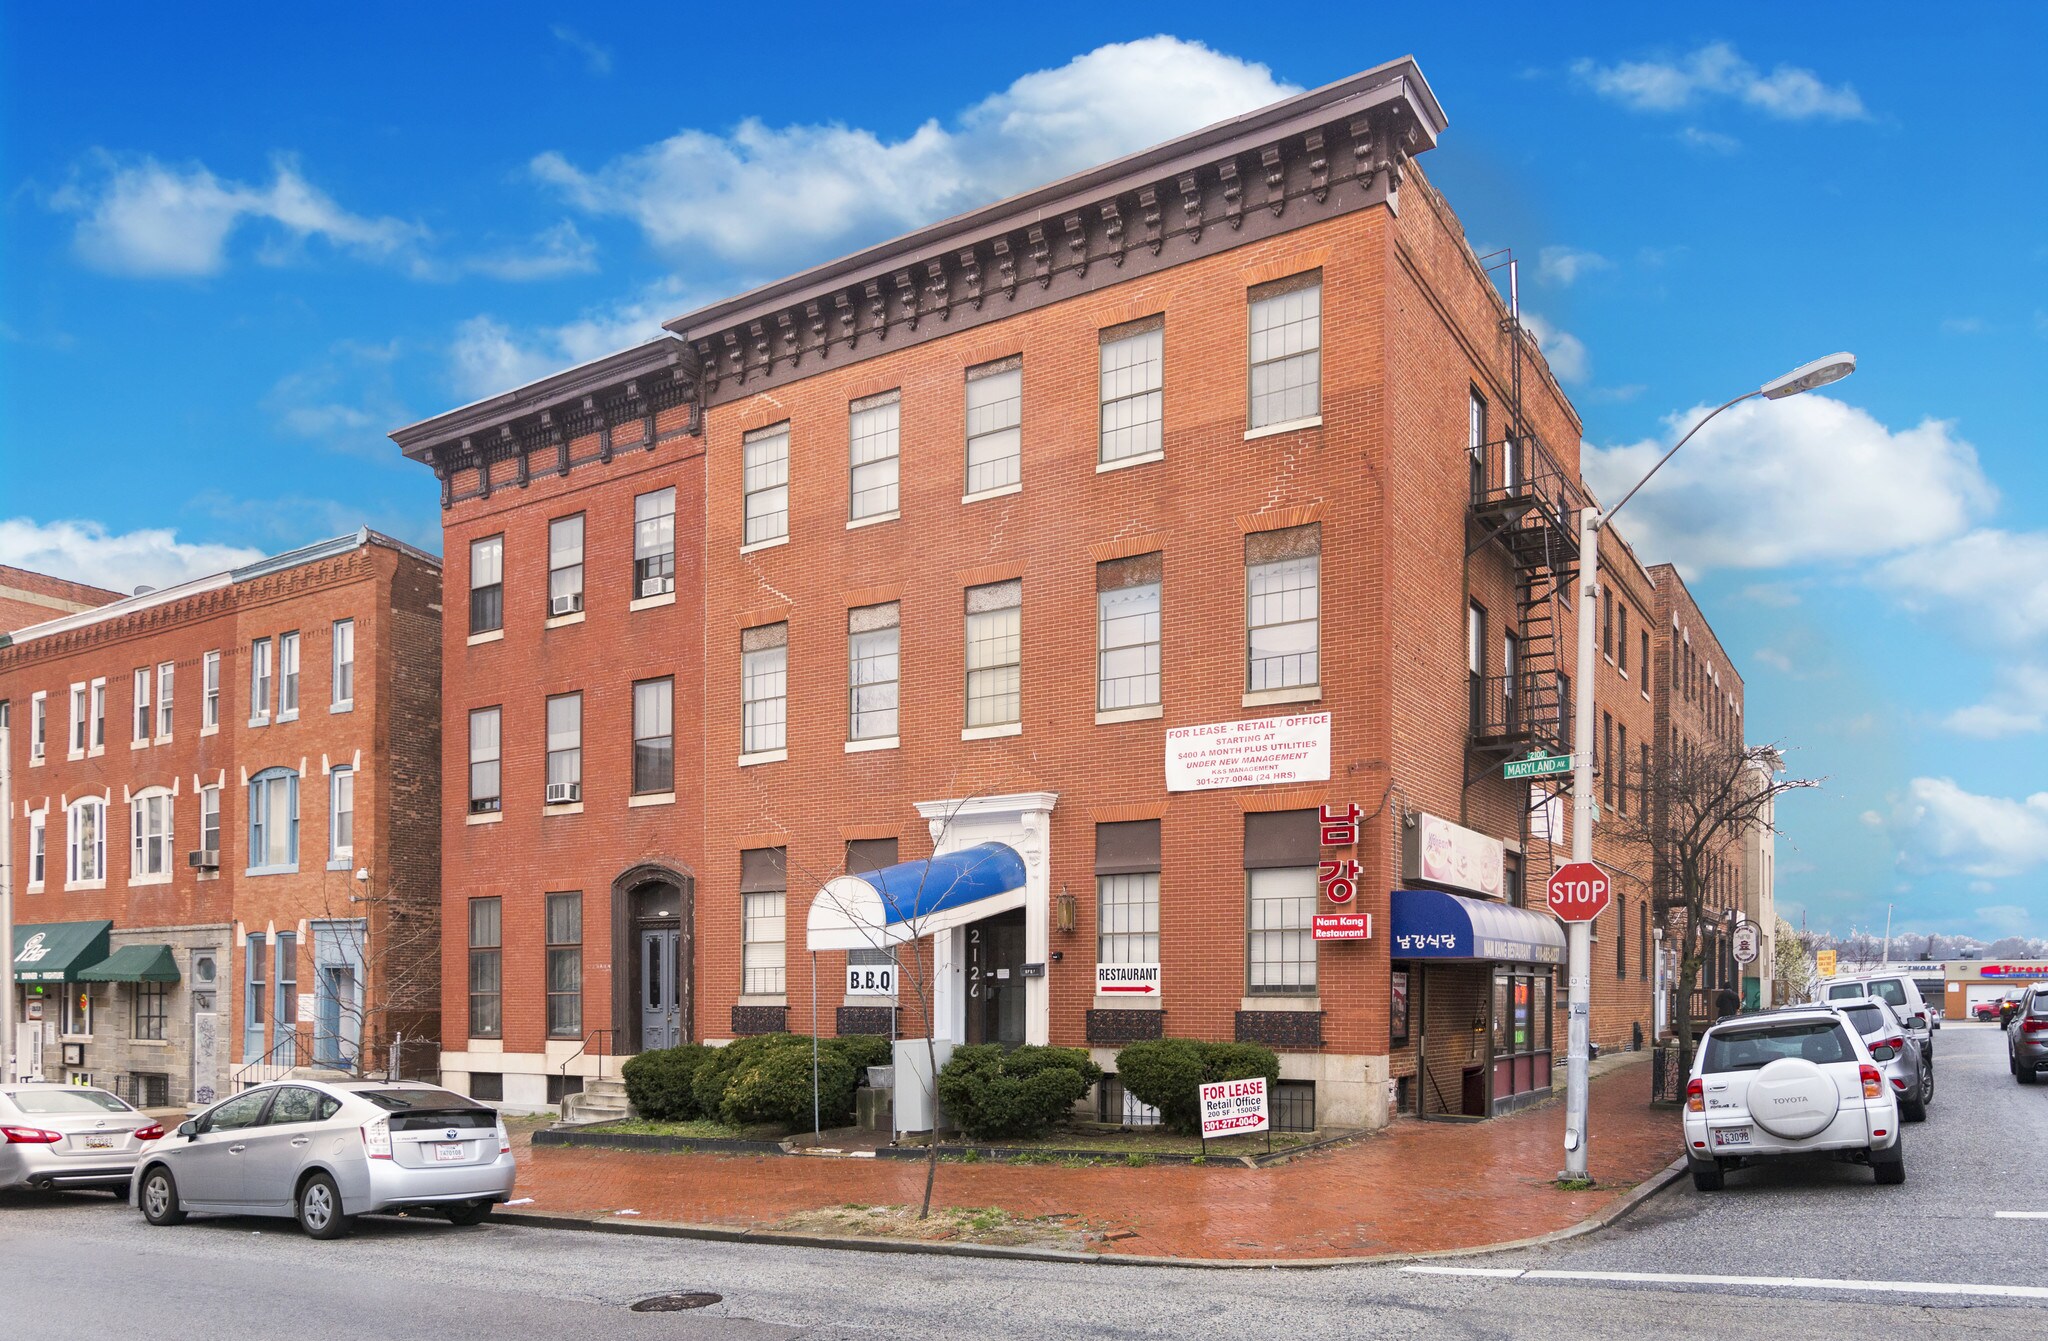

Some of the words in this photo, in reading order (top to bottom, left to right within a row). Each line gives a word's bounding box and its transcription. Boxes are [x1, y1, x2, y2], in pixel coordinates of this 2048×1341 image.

[1168, 729, 1190, 739] FOR
[1193, 725, 1227, 737] LEASE
[1237, 720, 1276, 732] RETAIL
[1286, 714, 1329, 727] OFFICE
[1216, 735, 1261, 746] STARTING
[1264, 733, 1276, 741] AT
[1178, 751, 1198, 760] $400
[1200, 750, 1206, 758] A
[1208, 746, 1242, 757] MONTH
[1244, 744, 1268, 753] PLUS
[1270, 740, 1317, 751] UTILITIES
[1186, 759, 1217, 769] UNDER
[1219, 757, 1240, 766] NEW
[1241, 752, 1309, 764] MANAGEMENT
[1507, 760, 1556, 776] MARYLAND
[1228, 764, 1279, 773] MANAGEMENT
[1256, 773, 1270, 782] (24
[1273, 771, 1296, 780] HRS)
[1319, 803, 1364, 904] 남강
[1551, 880, 1606, 904] STOP
[1316, 917, 1338, 926] Nam
[1340, 916, 1364, 928] Kang
[1315, 928, 1364, 938] Restaurant
[1396, 934, 1456, 949] 남강식당
[1098, 967, 1158, 981] RESTAURANT
[1203, 1086, 1225, 1100] FOR
[1229, 1082, 1262, 1097] LEASE
[1773, 1096, 1808, 1104] TOYOTA
[1208, 1110, 1220, 1118] 200
[1237, 1105, 1261, 1114] 1500SF
[1204, 1115, 1259, 1131] 301-277-0048
